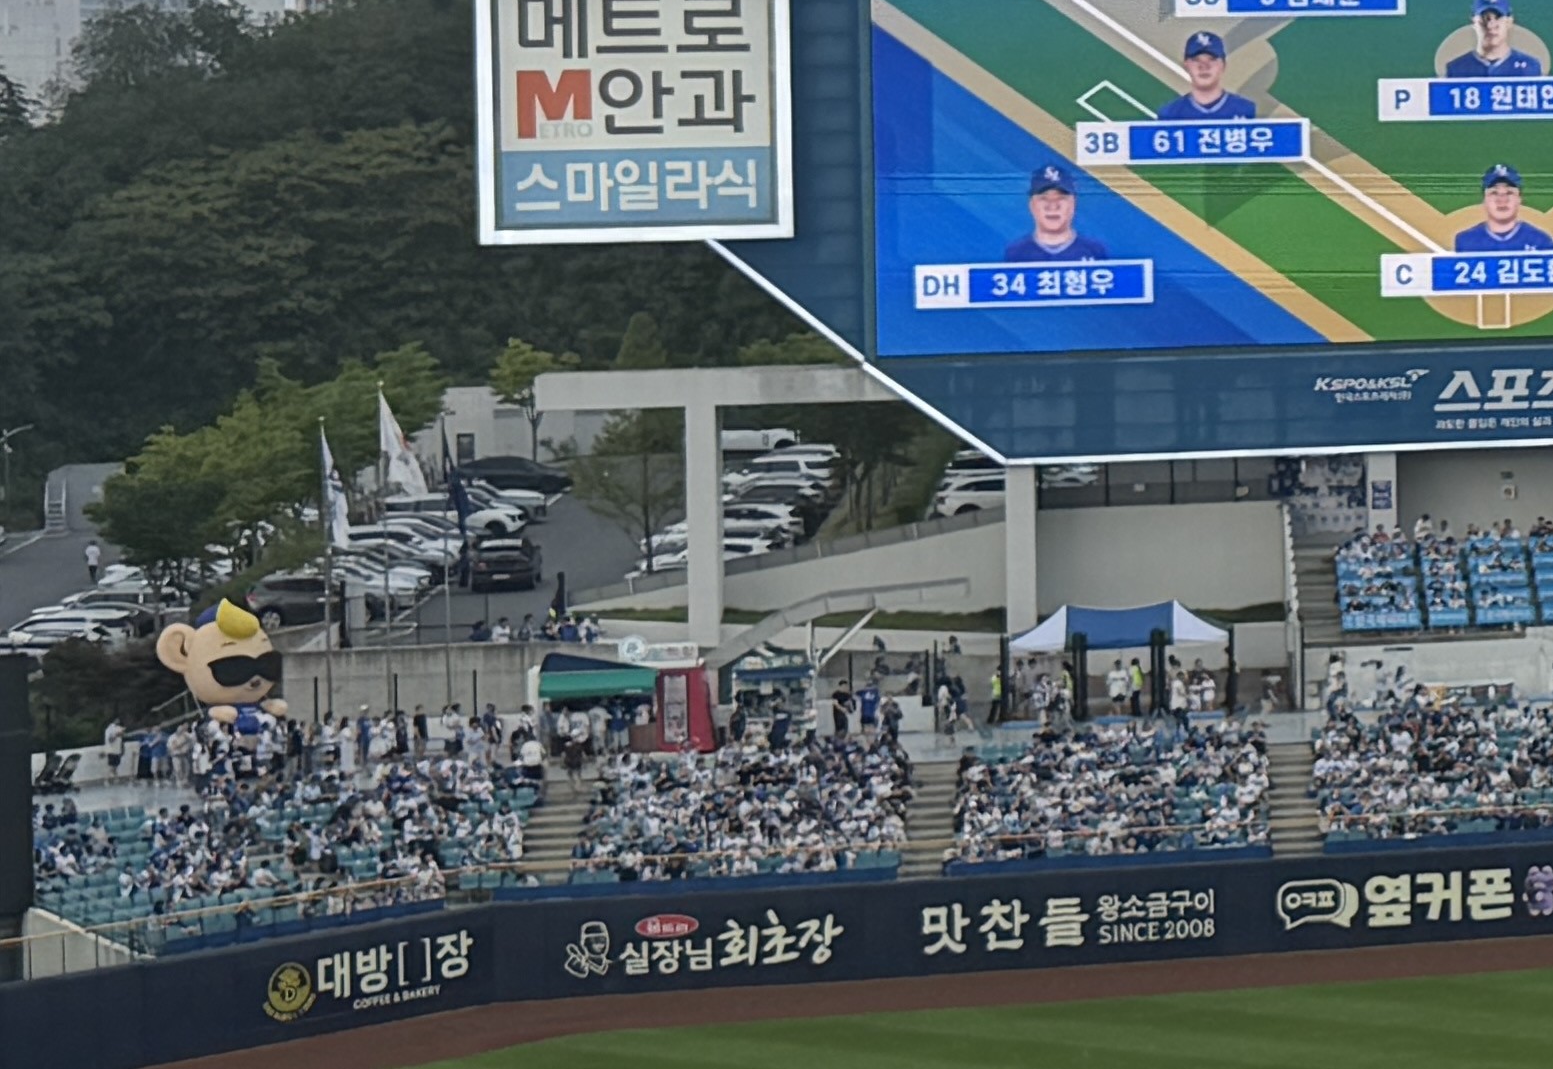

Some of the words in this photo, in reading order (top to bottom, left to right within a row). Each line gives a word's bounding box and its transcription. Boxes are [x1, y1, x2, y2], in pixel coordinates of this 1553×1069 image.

[516, 68, 593, 140] METRO
[598, 68, 756, 135] 안과
[1394, 88, 1411, 110] P
[1450, 87, 1480, 109] 18
[1084, 132, 1119, 154] 3B
[1153, 130, 1186, 154] 61
[1197, 126, 1274, 155] 전병우
[515, 158, 757, 212] 스마일라식
[922, 275, 961, 298] DH
[991, 272, 1027, 296] 34
[1037, 267, 1115, 296] 최형우
[1395, 264, 1413, 286] C
[1453, 262, 1487, 285] 24
[1097, 888, 1216, 920] 왕소금구이
[1364, 867, 1515, 928] 옆커폰
[717, 909, 843, 968] 회초장
[1099, 923, 1159, 944] SINCE
[1164, 918, 1216, 940] 2008
[619, 936, 713, 975] 실장님
[353, 993, 391, 1010] COFFEE
[402, 984, 441, 1001] BAKERY
